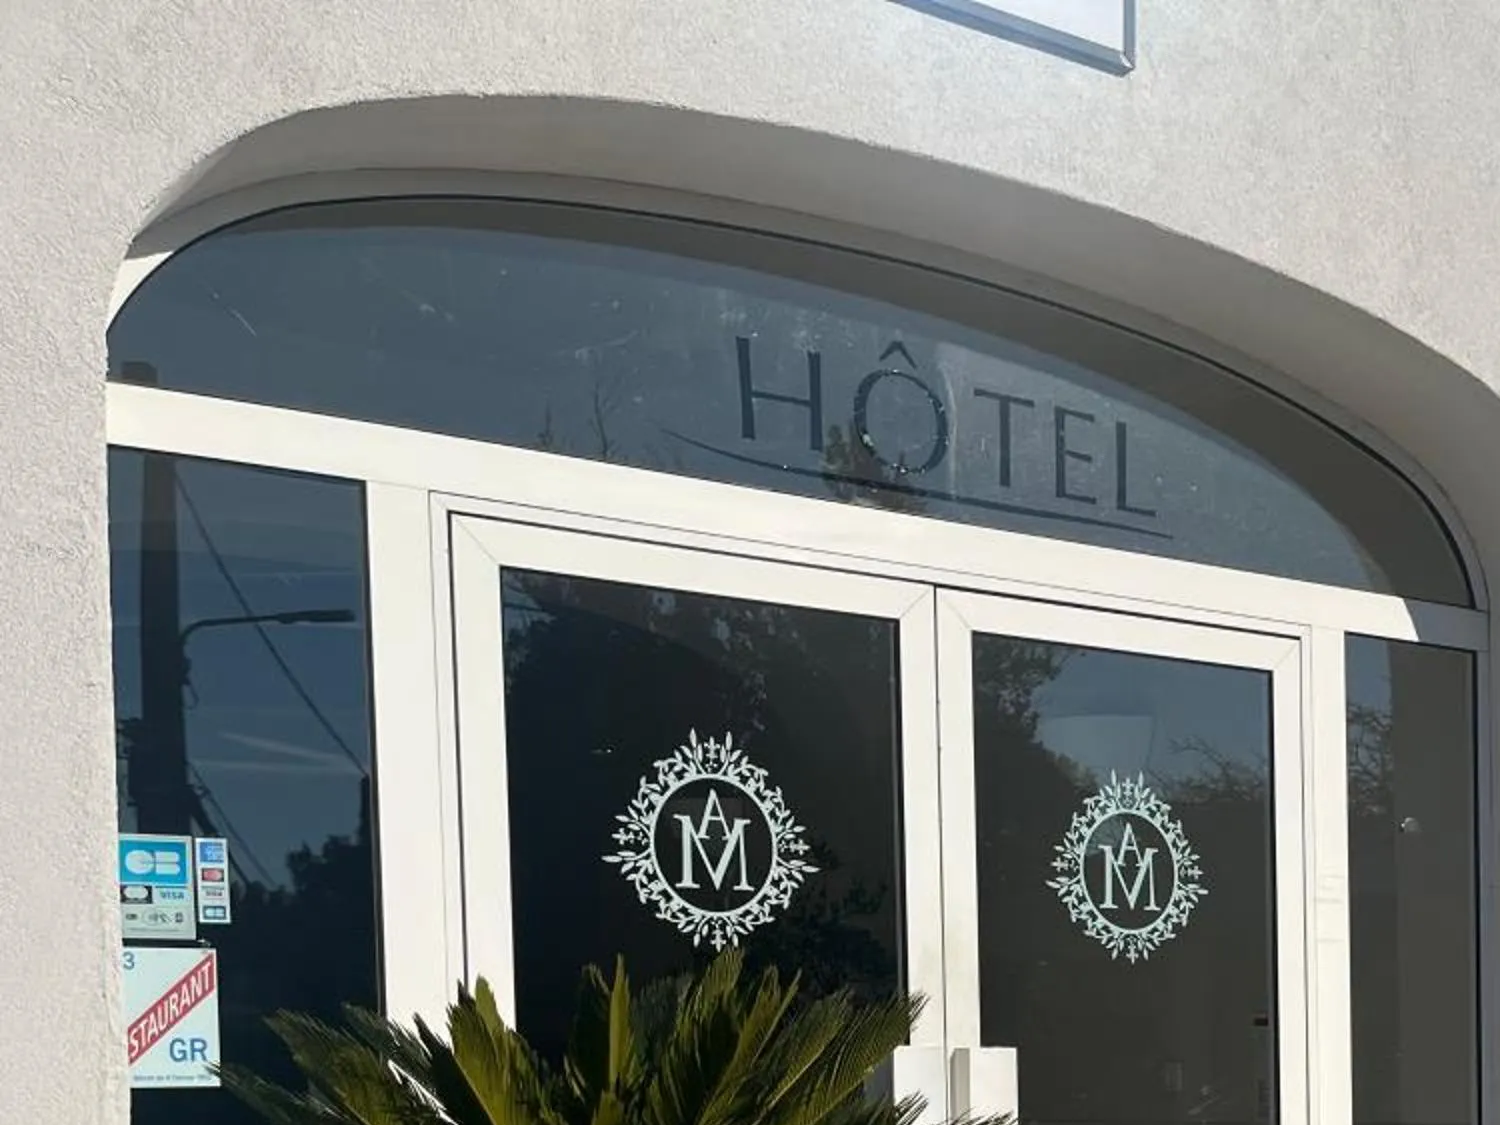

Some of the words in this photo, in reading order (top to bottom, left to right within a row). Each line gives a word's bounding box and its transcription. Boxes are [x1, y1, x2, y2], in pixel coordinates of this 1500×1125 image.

[736, 337, 1157, 516] HÔTEL
[159, 889, 185, 900] VISA
[169, 1037, 208, 1062] GR
